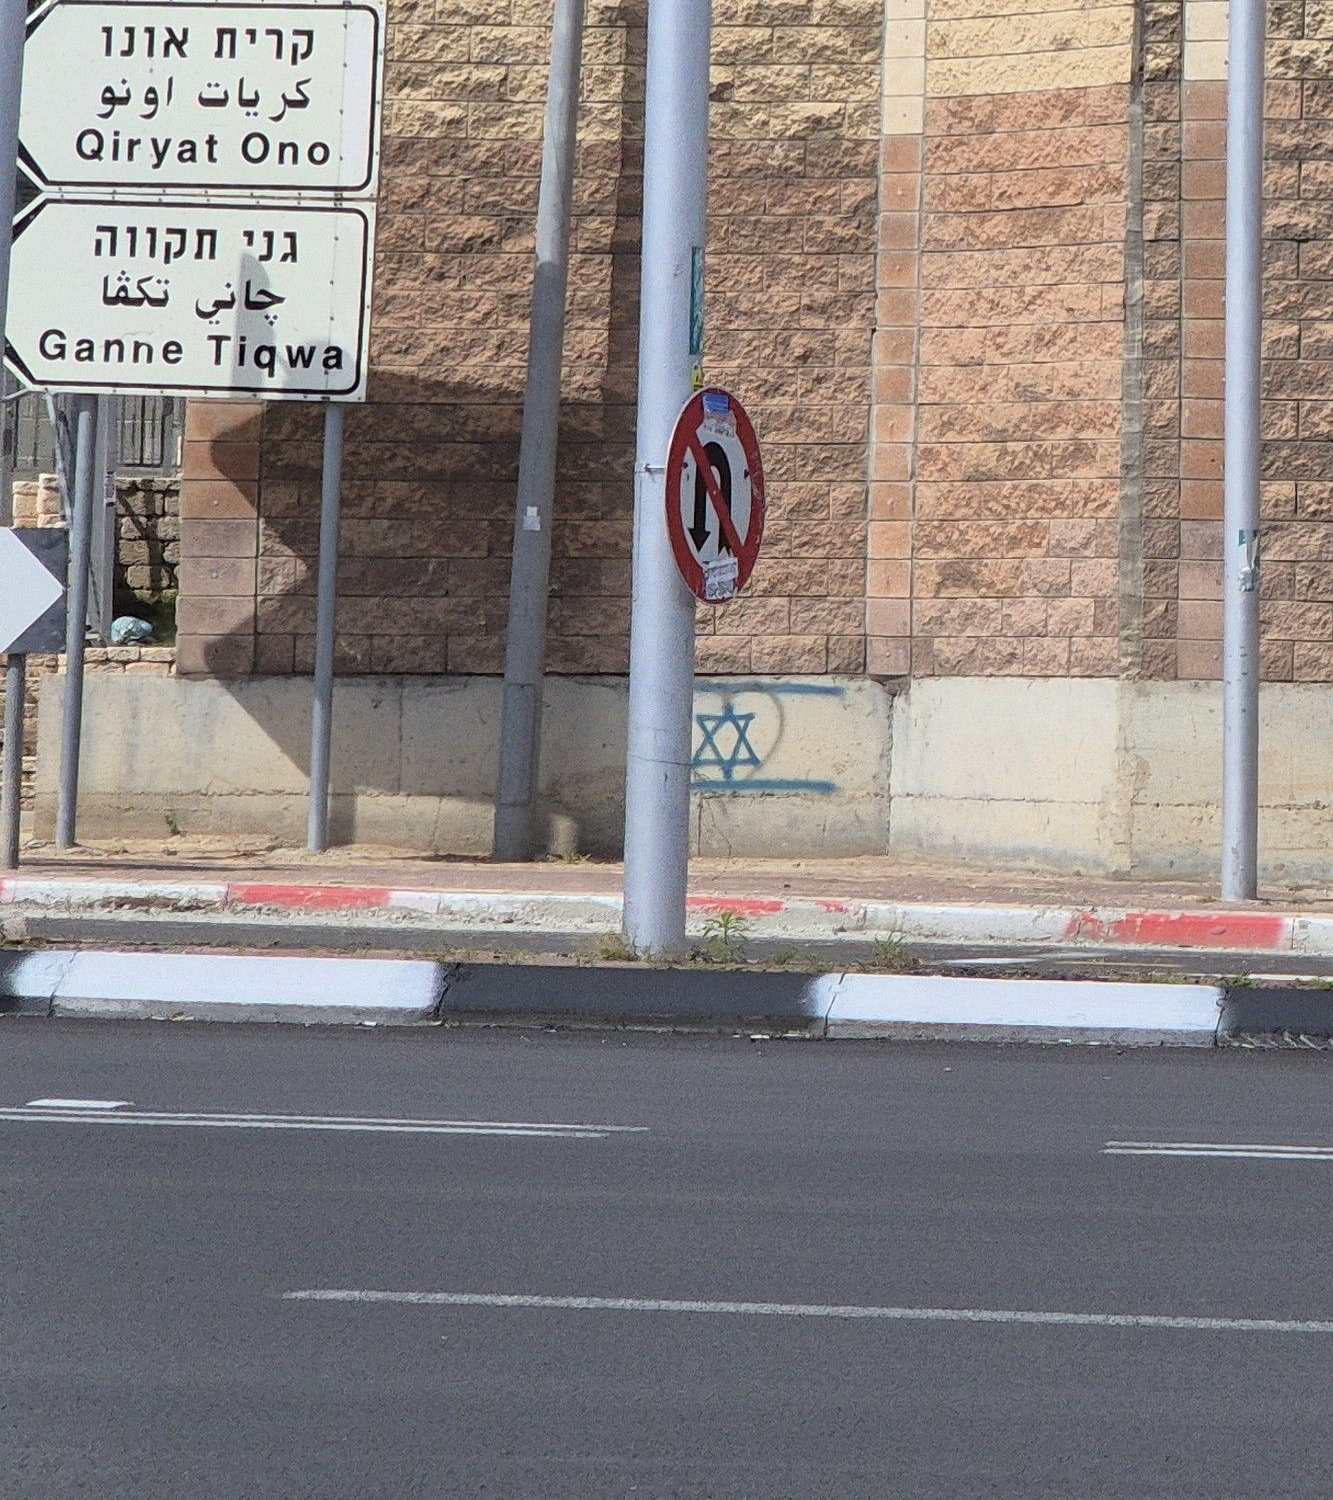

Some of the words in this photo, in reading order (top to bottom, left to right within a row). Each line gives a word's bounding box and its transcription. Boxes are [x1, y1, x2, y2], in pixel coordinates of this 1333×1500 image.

[101, 25, 189, 58] אונו
[214, 27, 314, 66] קרית
[97, 76, 173, 120] اونو
[198, 76, 312, 122] كريات
[75, 128, 218, 170] Qiryat
[241, 131, 331, 166] Ono
[94, 225, 218, 265] תקווה
[242, 230, 297, 263] גני
[39, 328, 184, 365] Ganne
[207, 334, 344, 379] Tiqwa
